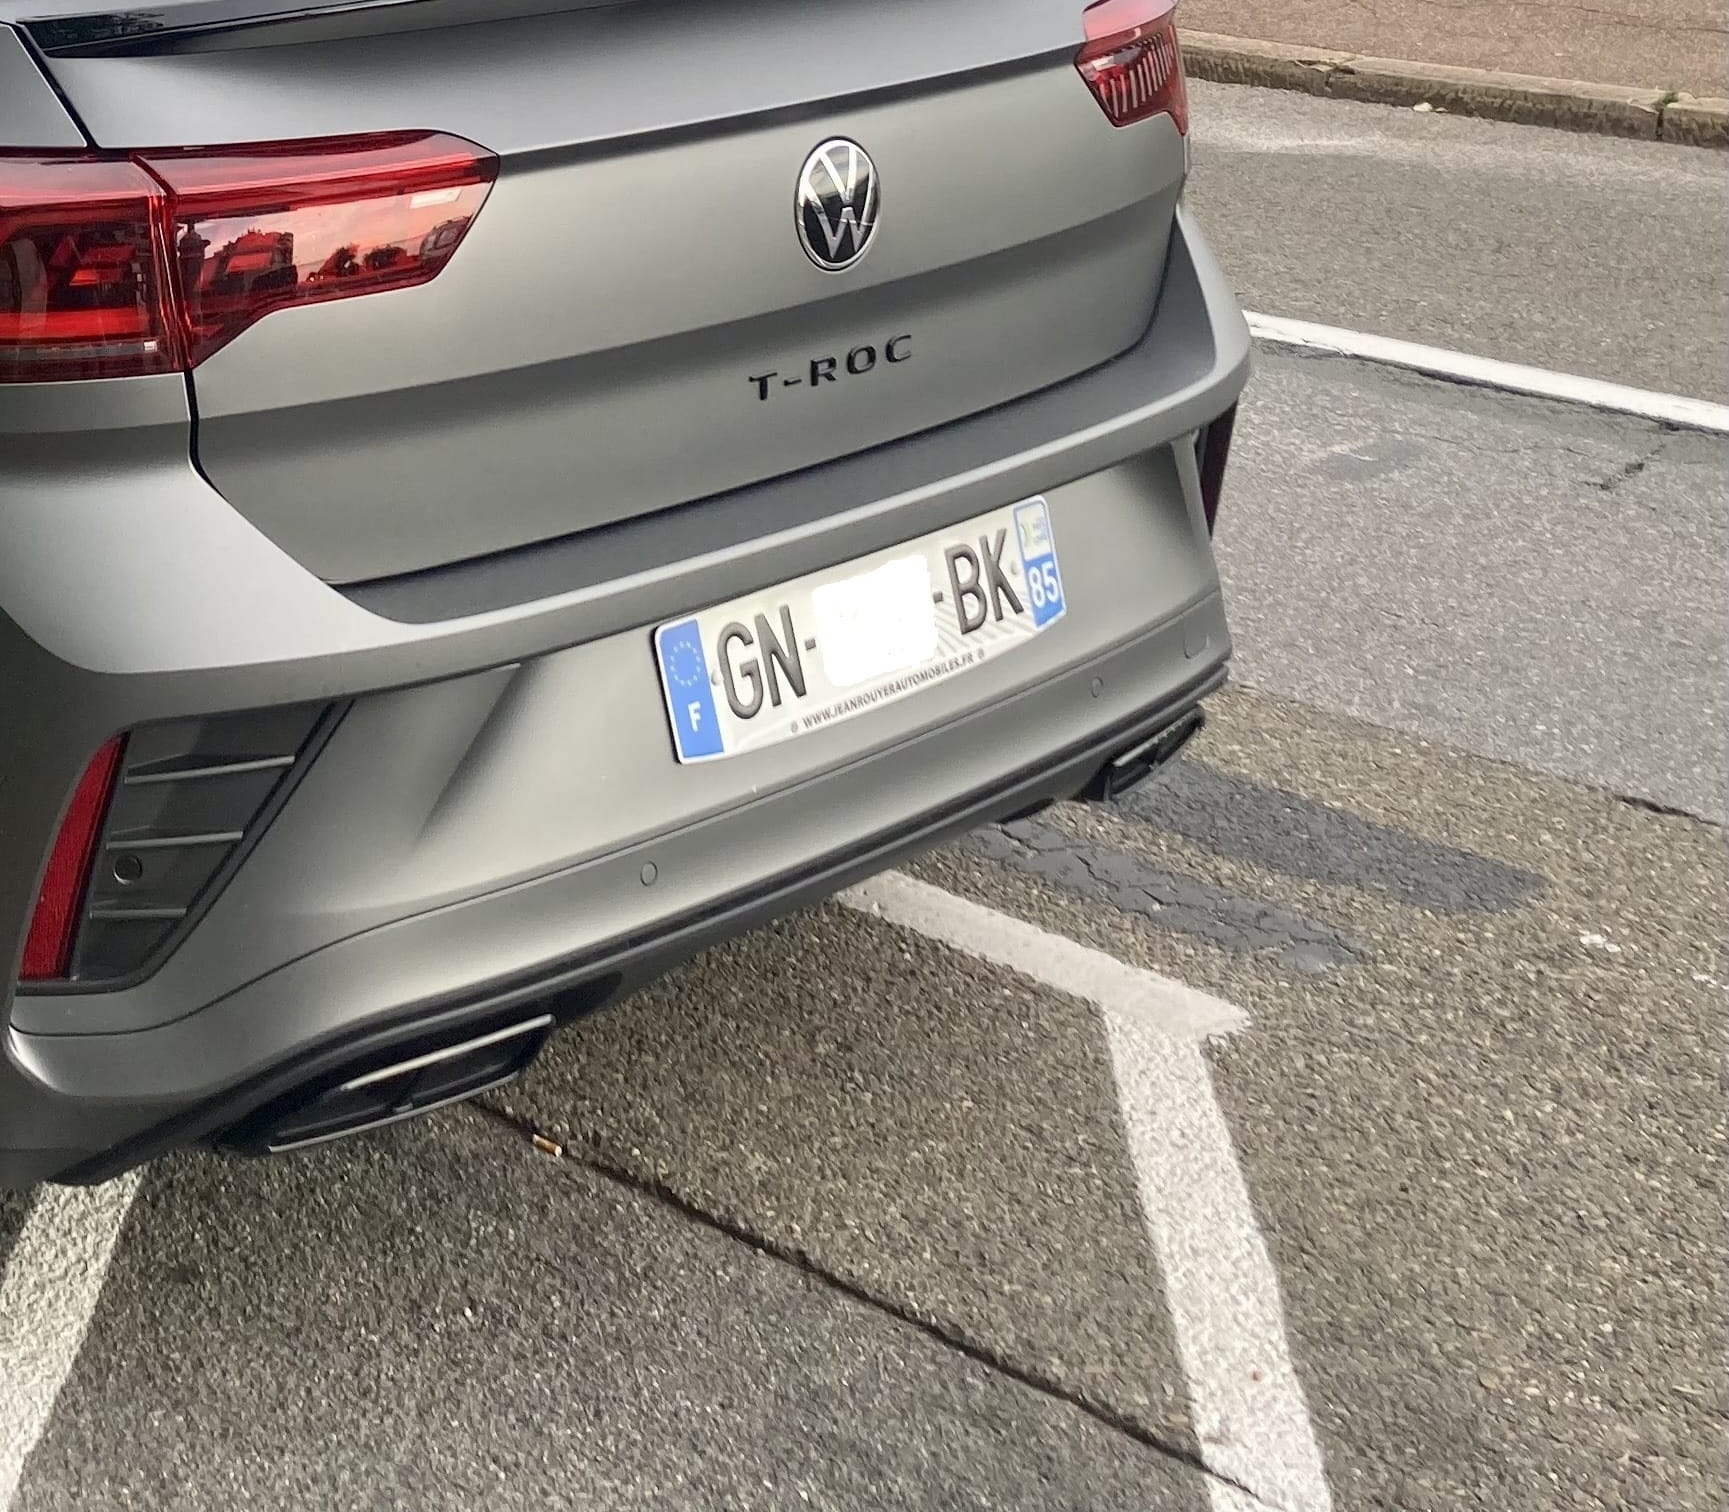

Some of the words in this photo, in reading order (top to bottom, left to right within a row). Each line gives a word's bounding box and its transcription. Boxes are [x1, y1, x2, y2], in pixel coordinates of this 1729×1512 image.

[748, 334, 913, 401] T-ROC
[1028, 560, 1060, 609] 85
[687, 700, 703, 733] F
[802, 652, 975, 730] WWW.JEANROUYERAUTOMOBILES.FR
